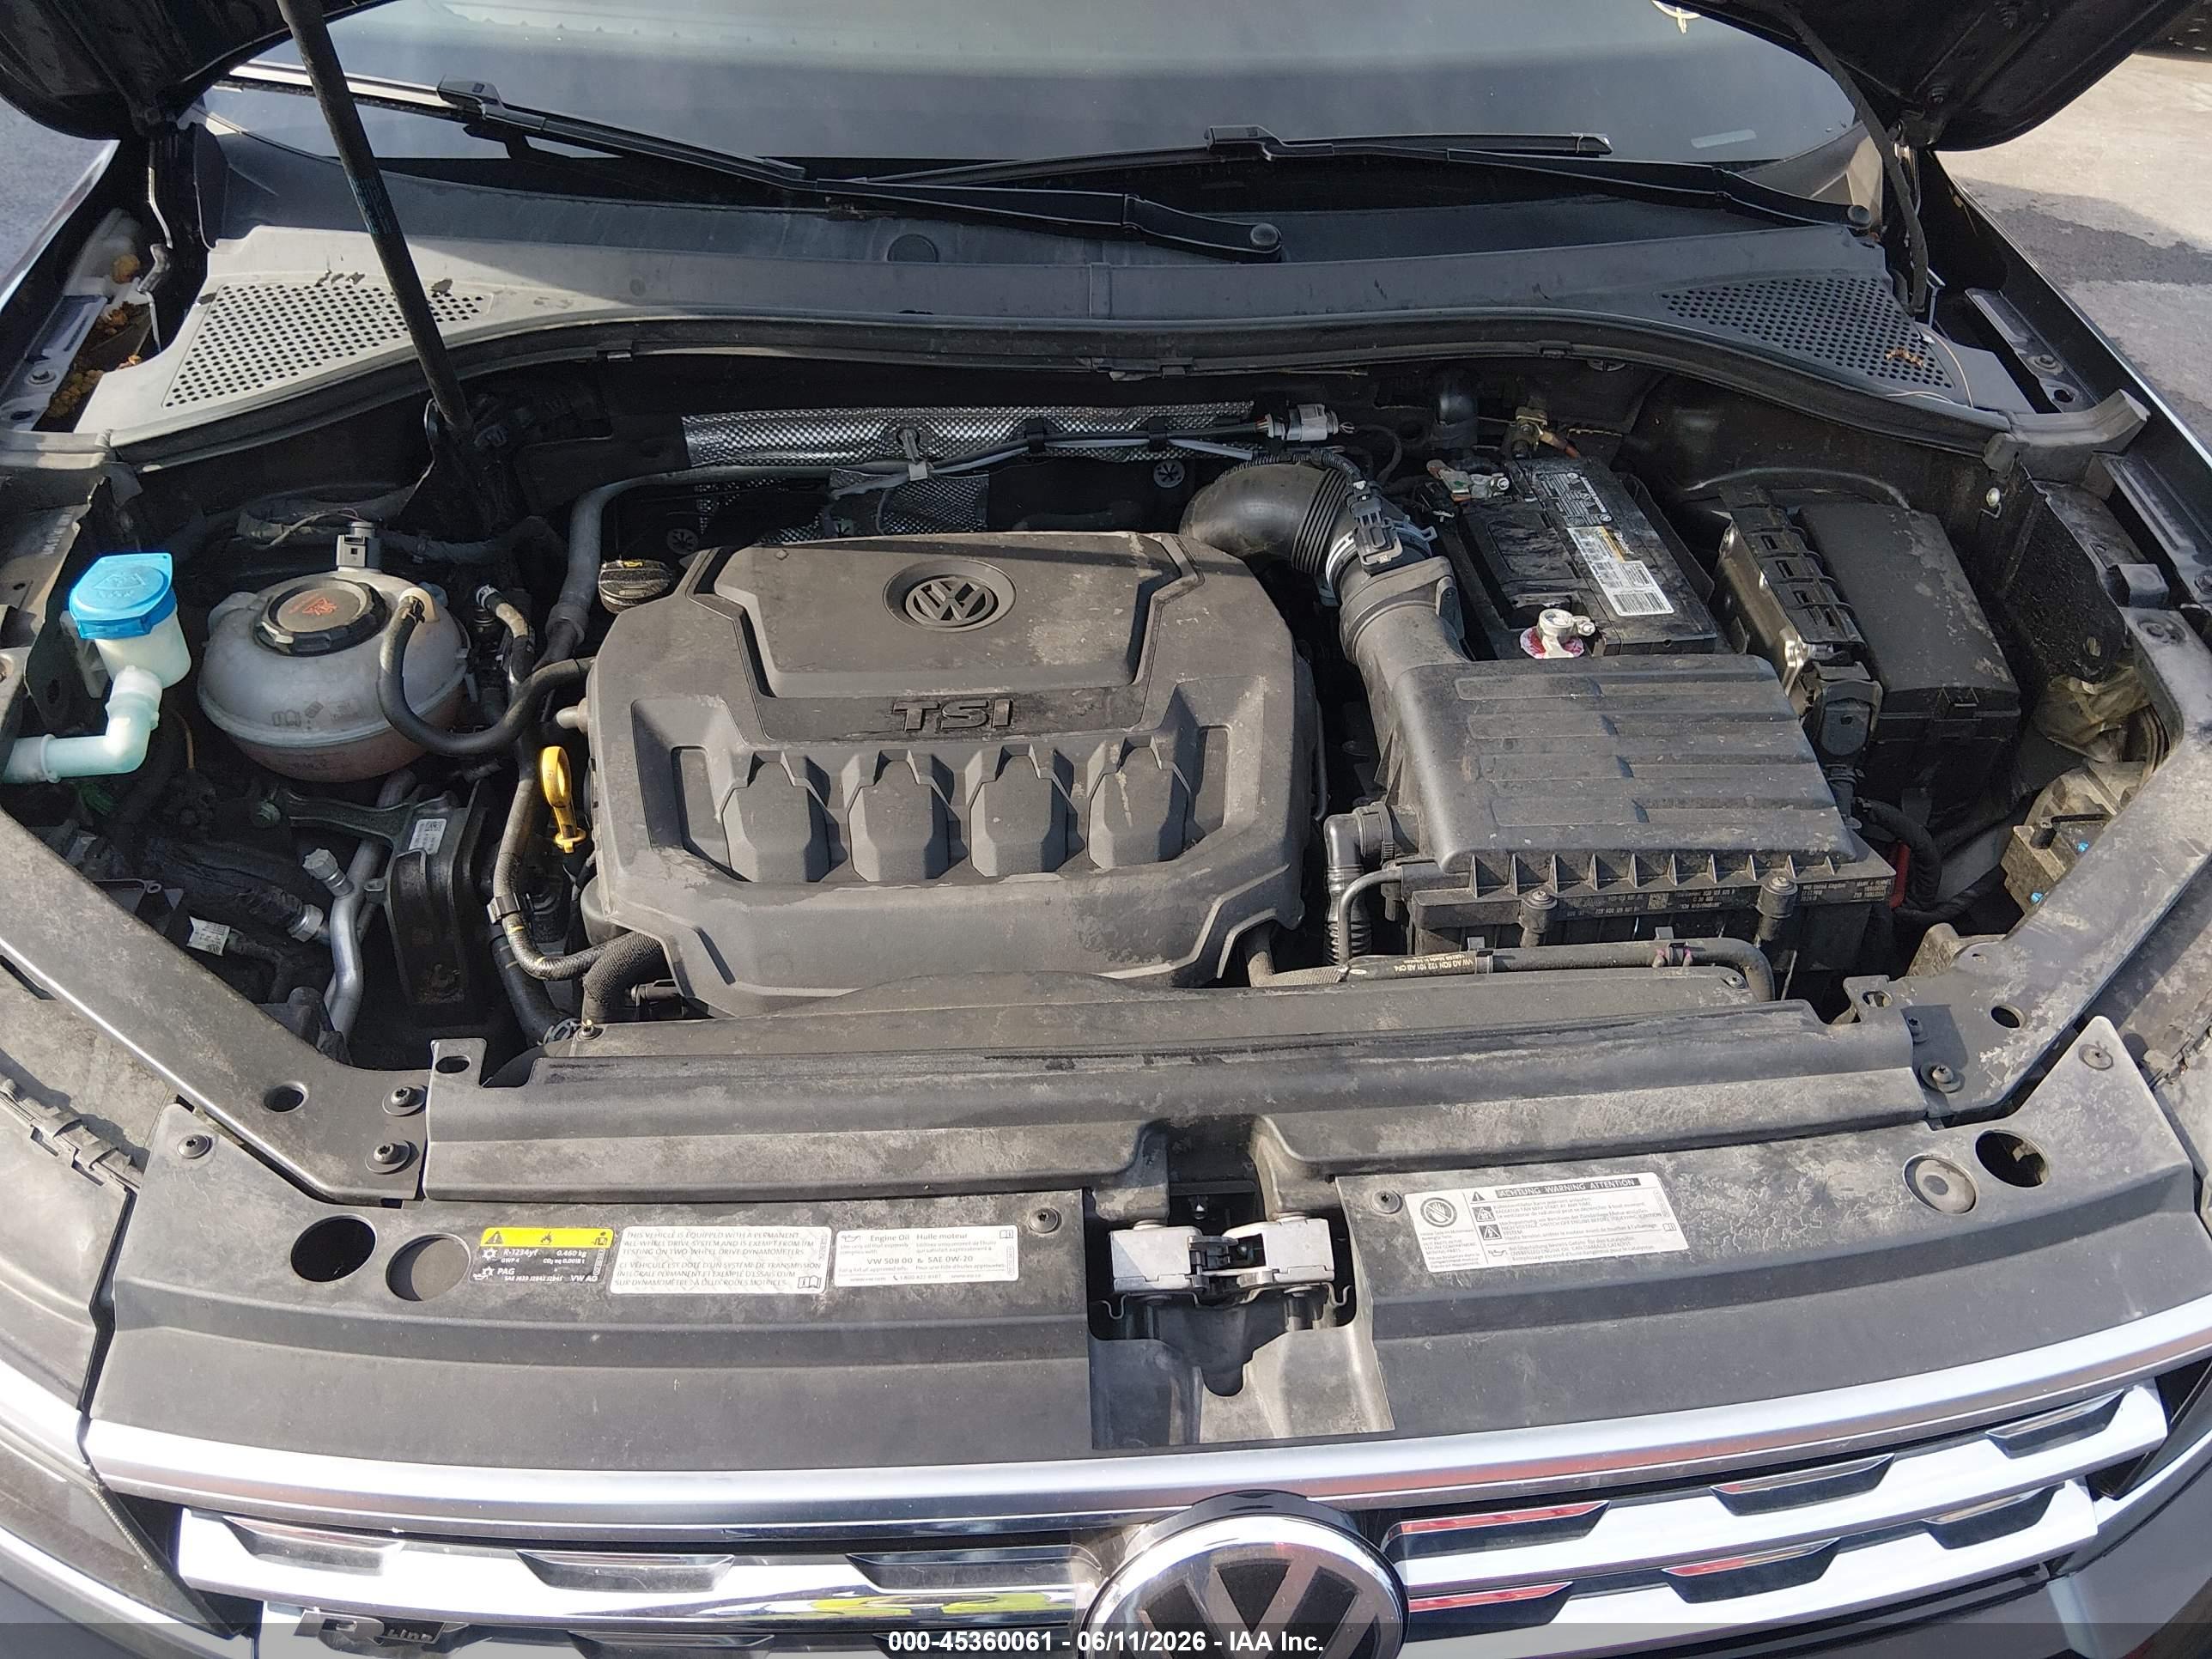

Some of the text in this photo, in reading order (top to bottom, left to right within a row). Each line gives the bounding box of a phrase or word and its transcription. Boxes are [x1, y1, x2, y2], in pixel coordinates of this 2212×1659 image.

[892, 698, 1015, 732] TSI
[1498, 1177, 1635, 1197] ACHTUNG WARNING ATTENTION
[870, 1234, 896, 1243] Engine
